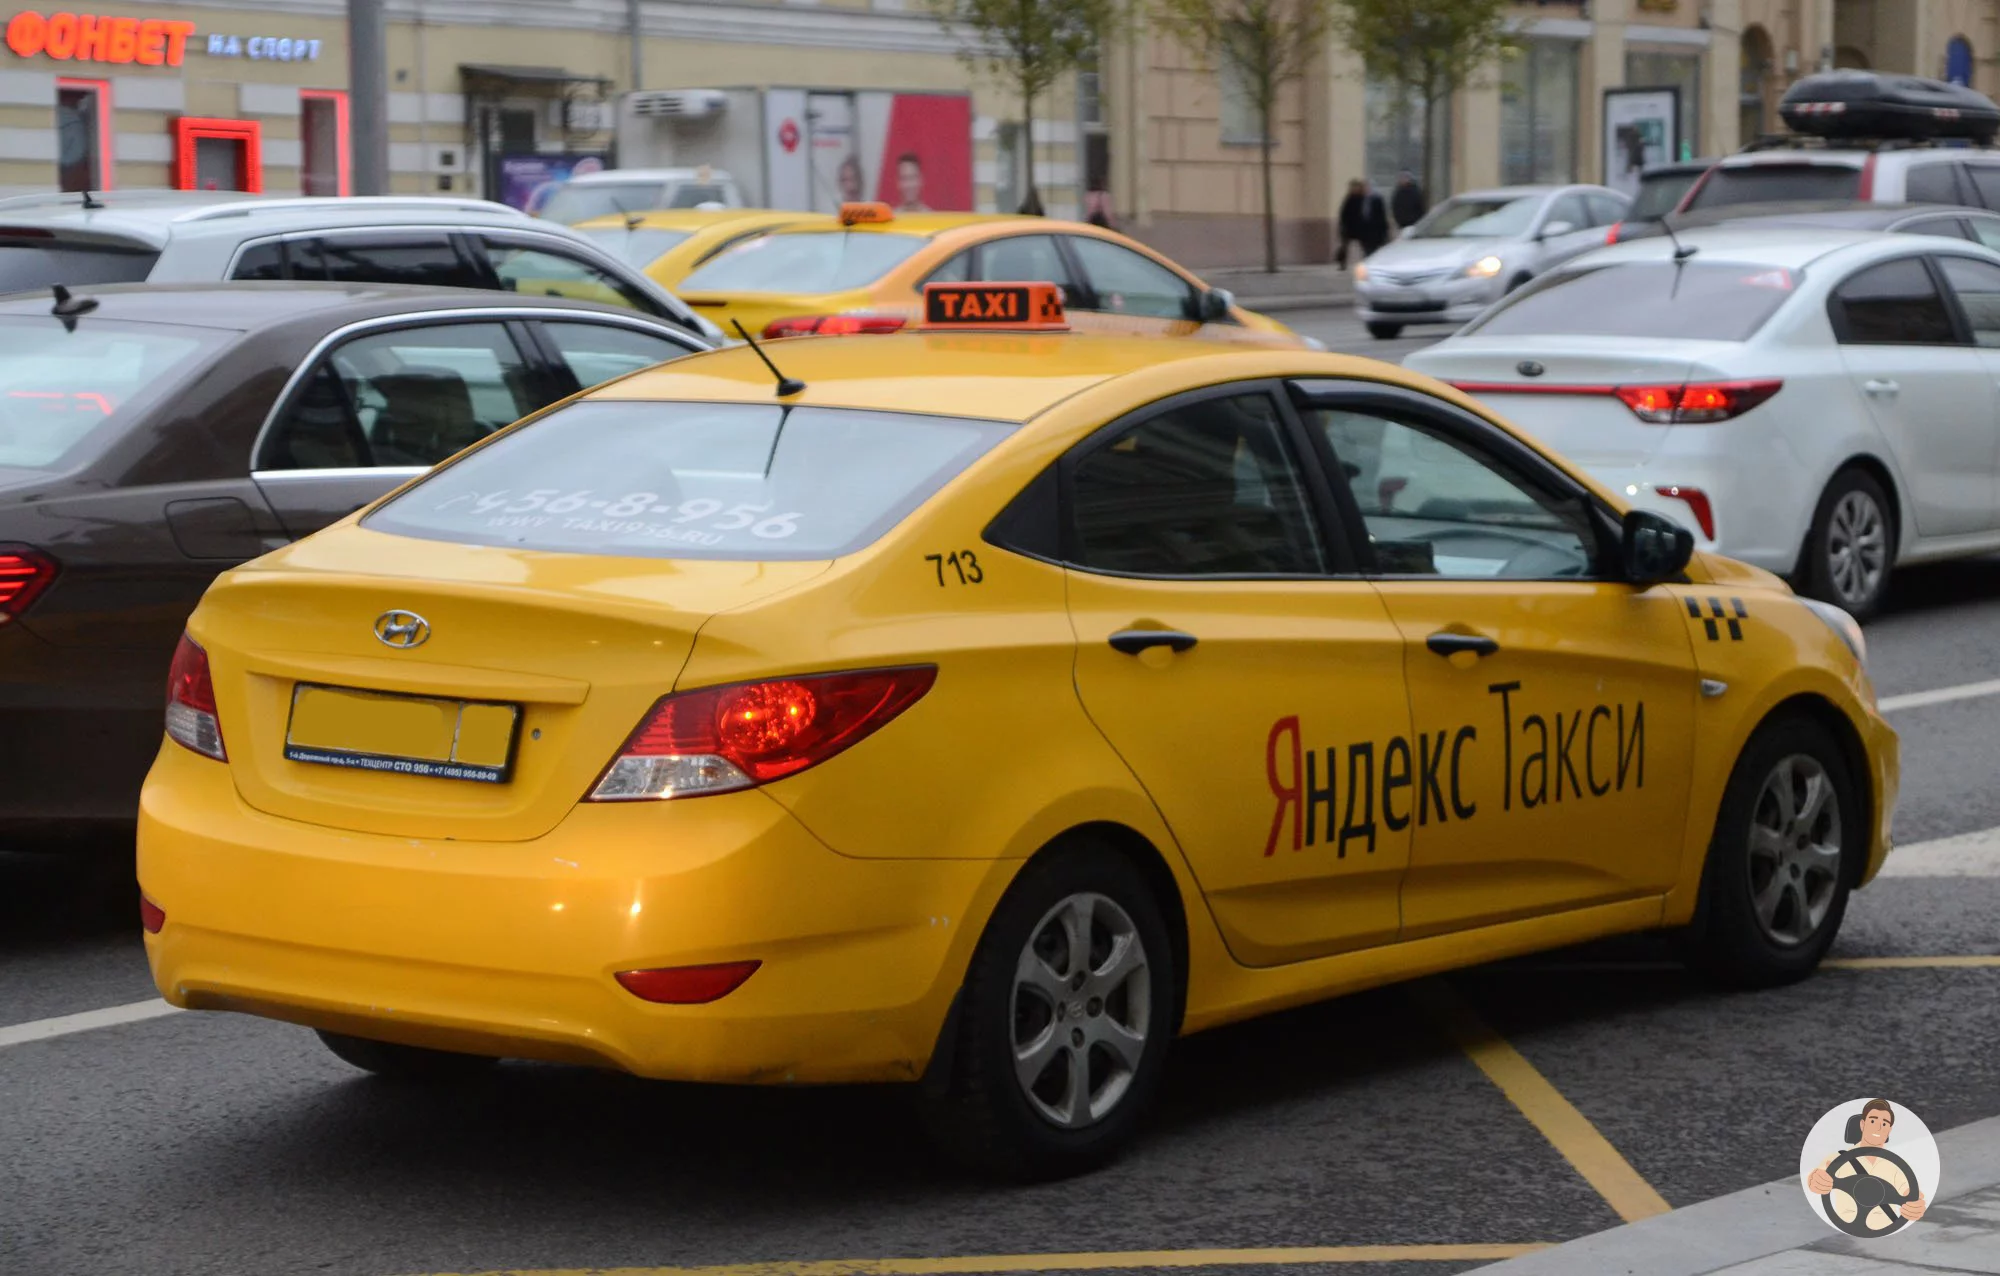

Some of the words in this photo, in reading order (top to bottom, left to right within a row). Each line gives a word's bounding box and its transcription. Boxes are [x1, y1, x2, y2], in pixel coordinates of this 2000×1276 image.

[7, 10, 196, 67] ФОНБЕТ
[207, 34, 241, 56] НА
[247, 36, 322, 61] СПОРТ
[938, 291, 1018, 318] TAXI
[923, 550, 984, 588] 713
[360, 758, 393, 770] ТЕХЦЕНТР
[393, 761, 412, 771] СТО
[413, 763, 429, 774] 956
[434, 766, 443, 775] +7
[1263, 714, 1478, 860] Яндекс
[1488, 680, 1645, 812] Такси
